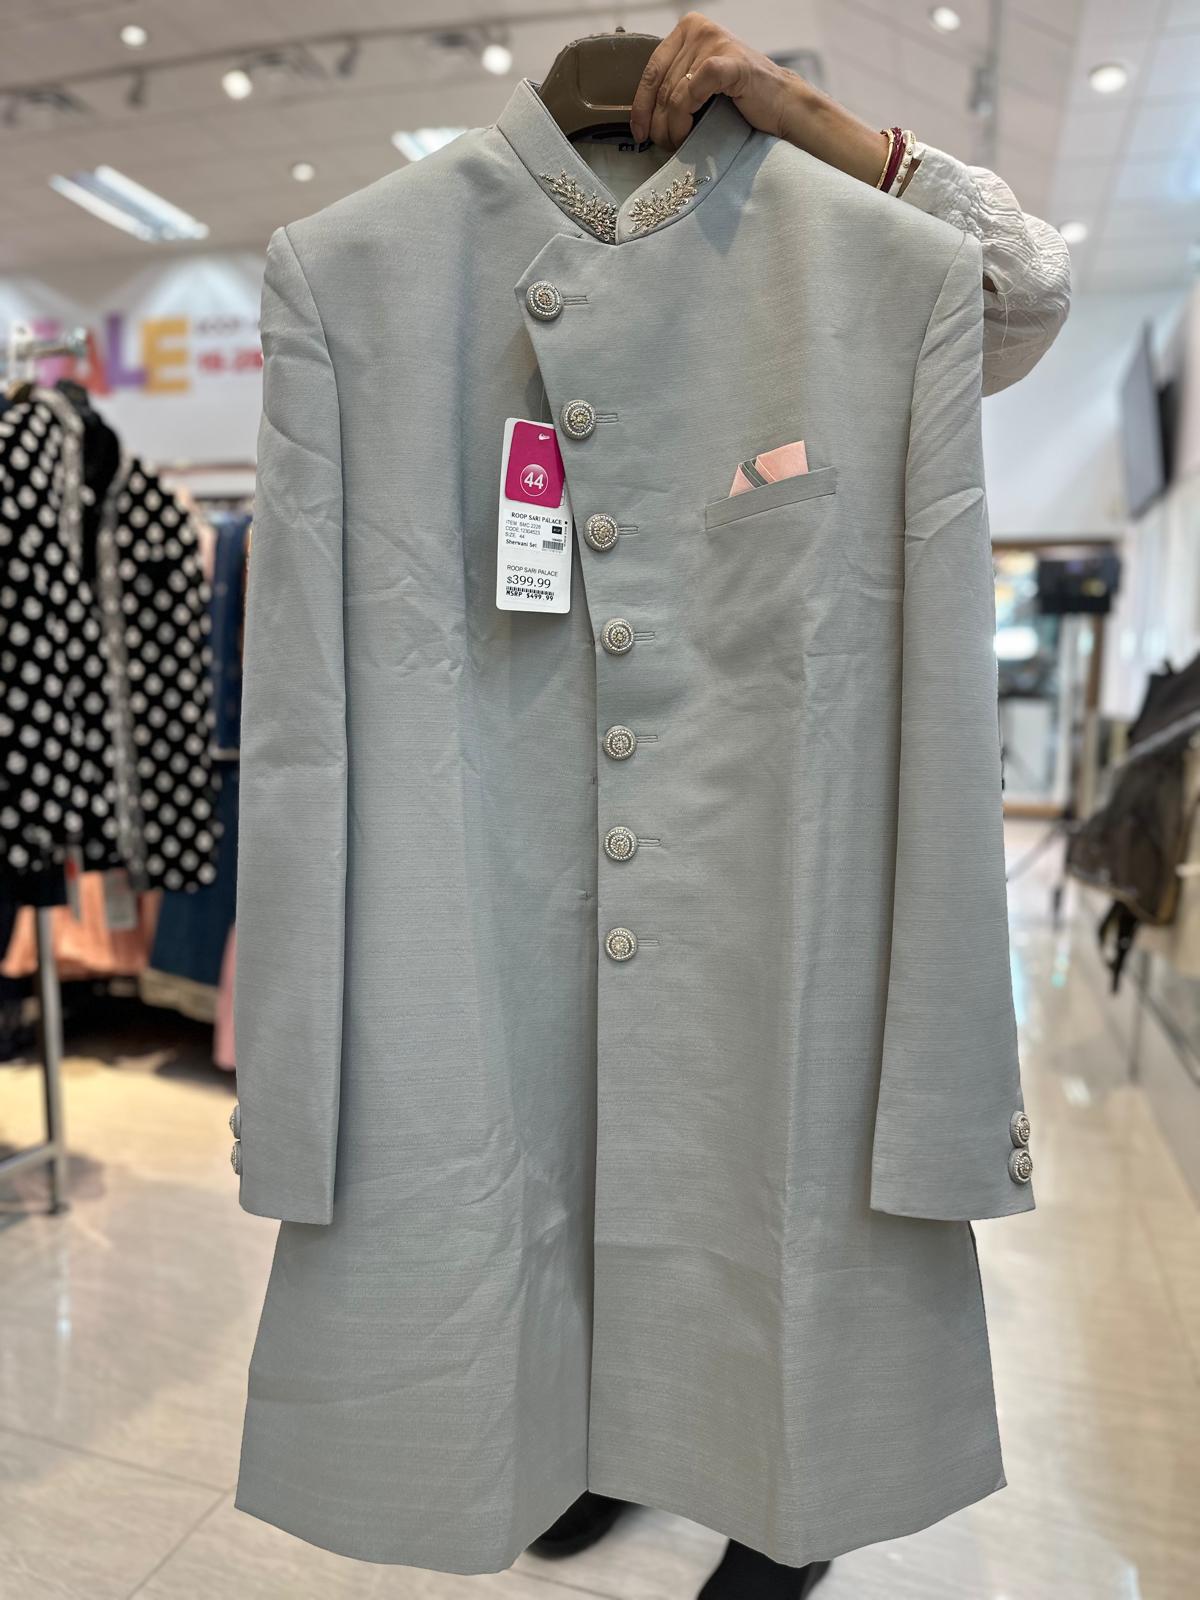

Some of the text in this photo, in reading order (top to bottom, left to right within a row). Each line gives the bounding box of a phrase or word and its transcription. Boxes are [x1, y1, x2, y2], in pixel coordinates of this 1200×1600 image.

[524, 471, 544, 490] 44
[512, 512, 528, 520] ROOP
[542, 517, 562, 525] PALACE
[506, 539, 528, 547] Sherwani
[538, 569, 558, 577] PALACE
[507, 575, 551, 589] $399.99
[526, 592, 554, 602] $499.99
